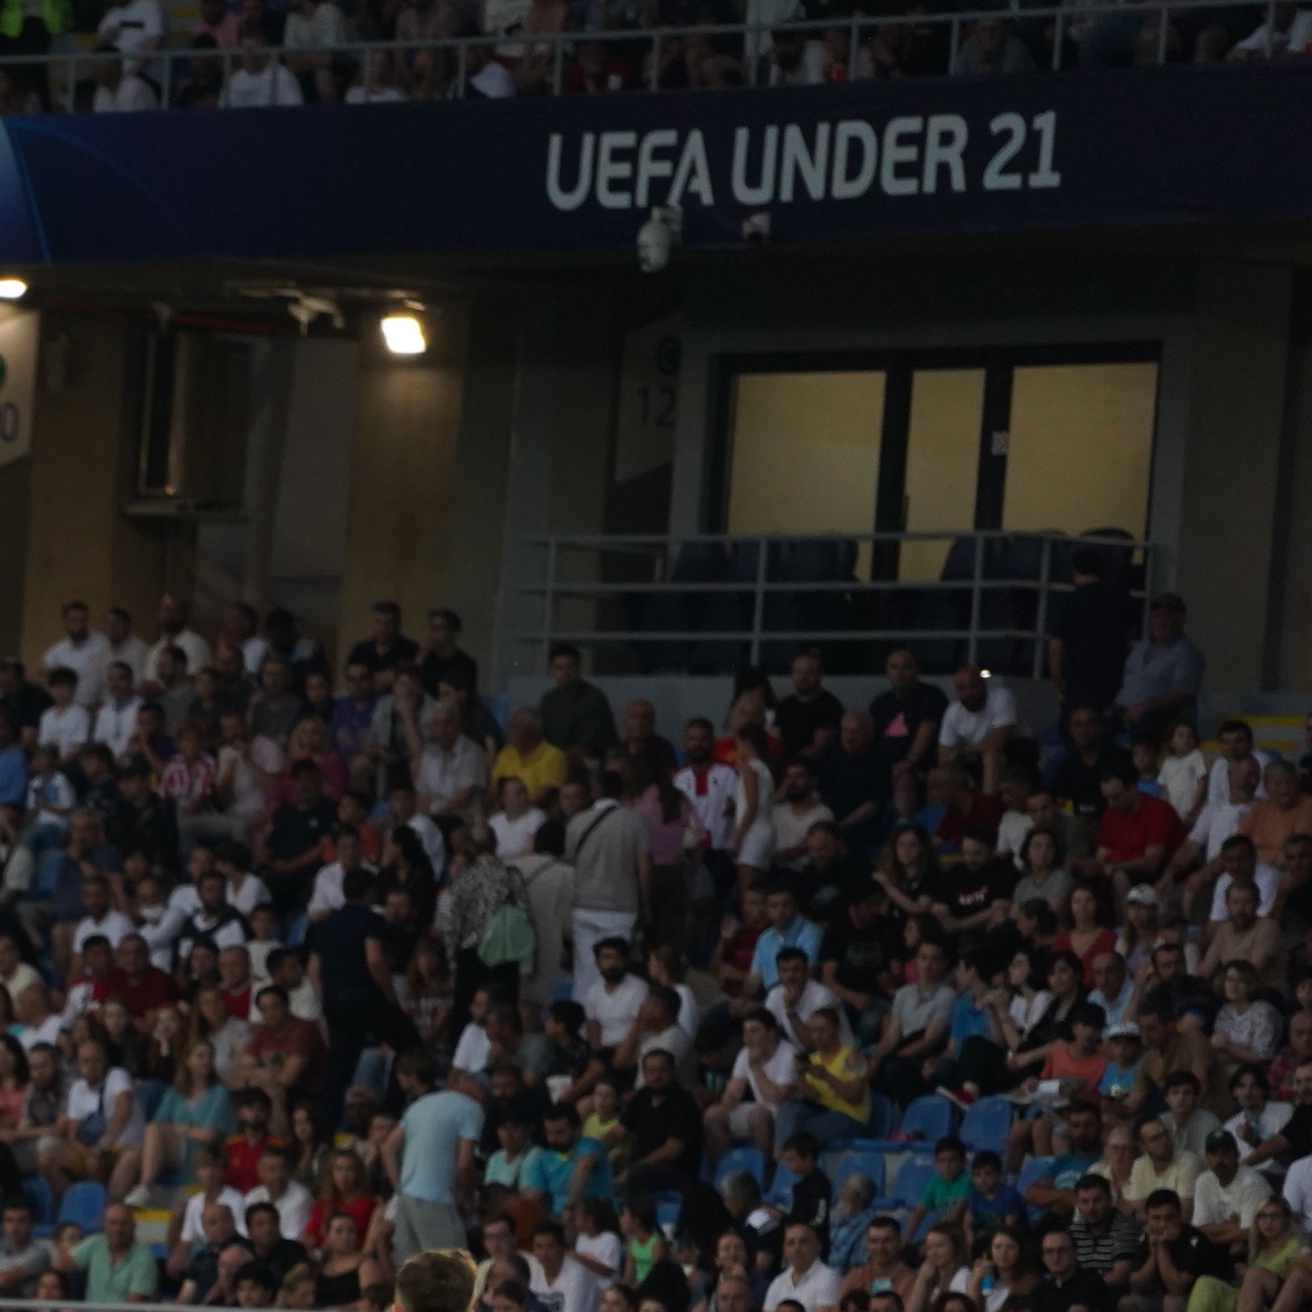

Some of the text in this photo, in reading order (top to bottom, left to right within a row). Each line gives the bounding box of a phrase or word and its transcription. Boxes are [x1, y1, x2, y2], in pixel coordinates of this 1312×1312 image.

[545, 110, 1061, 211] UEFA UNDER 21
[638, 386, 676, 429] 12
